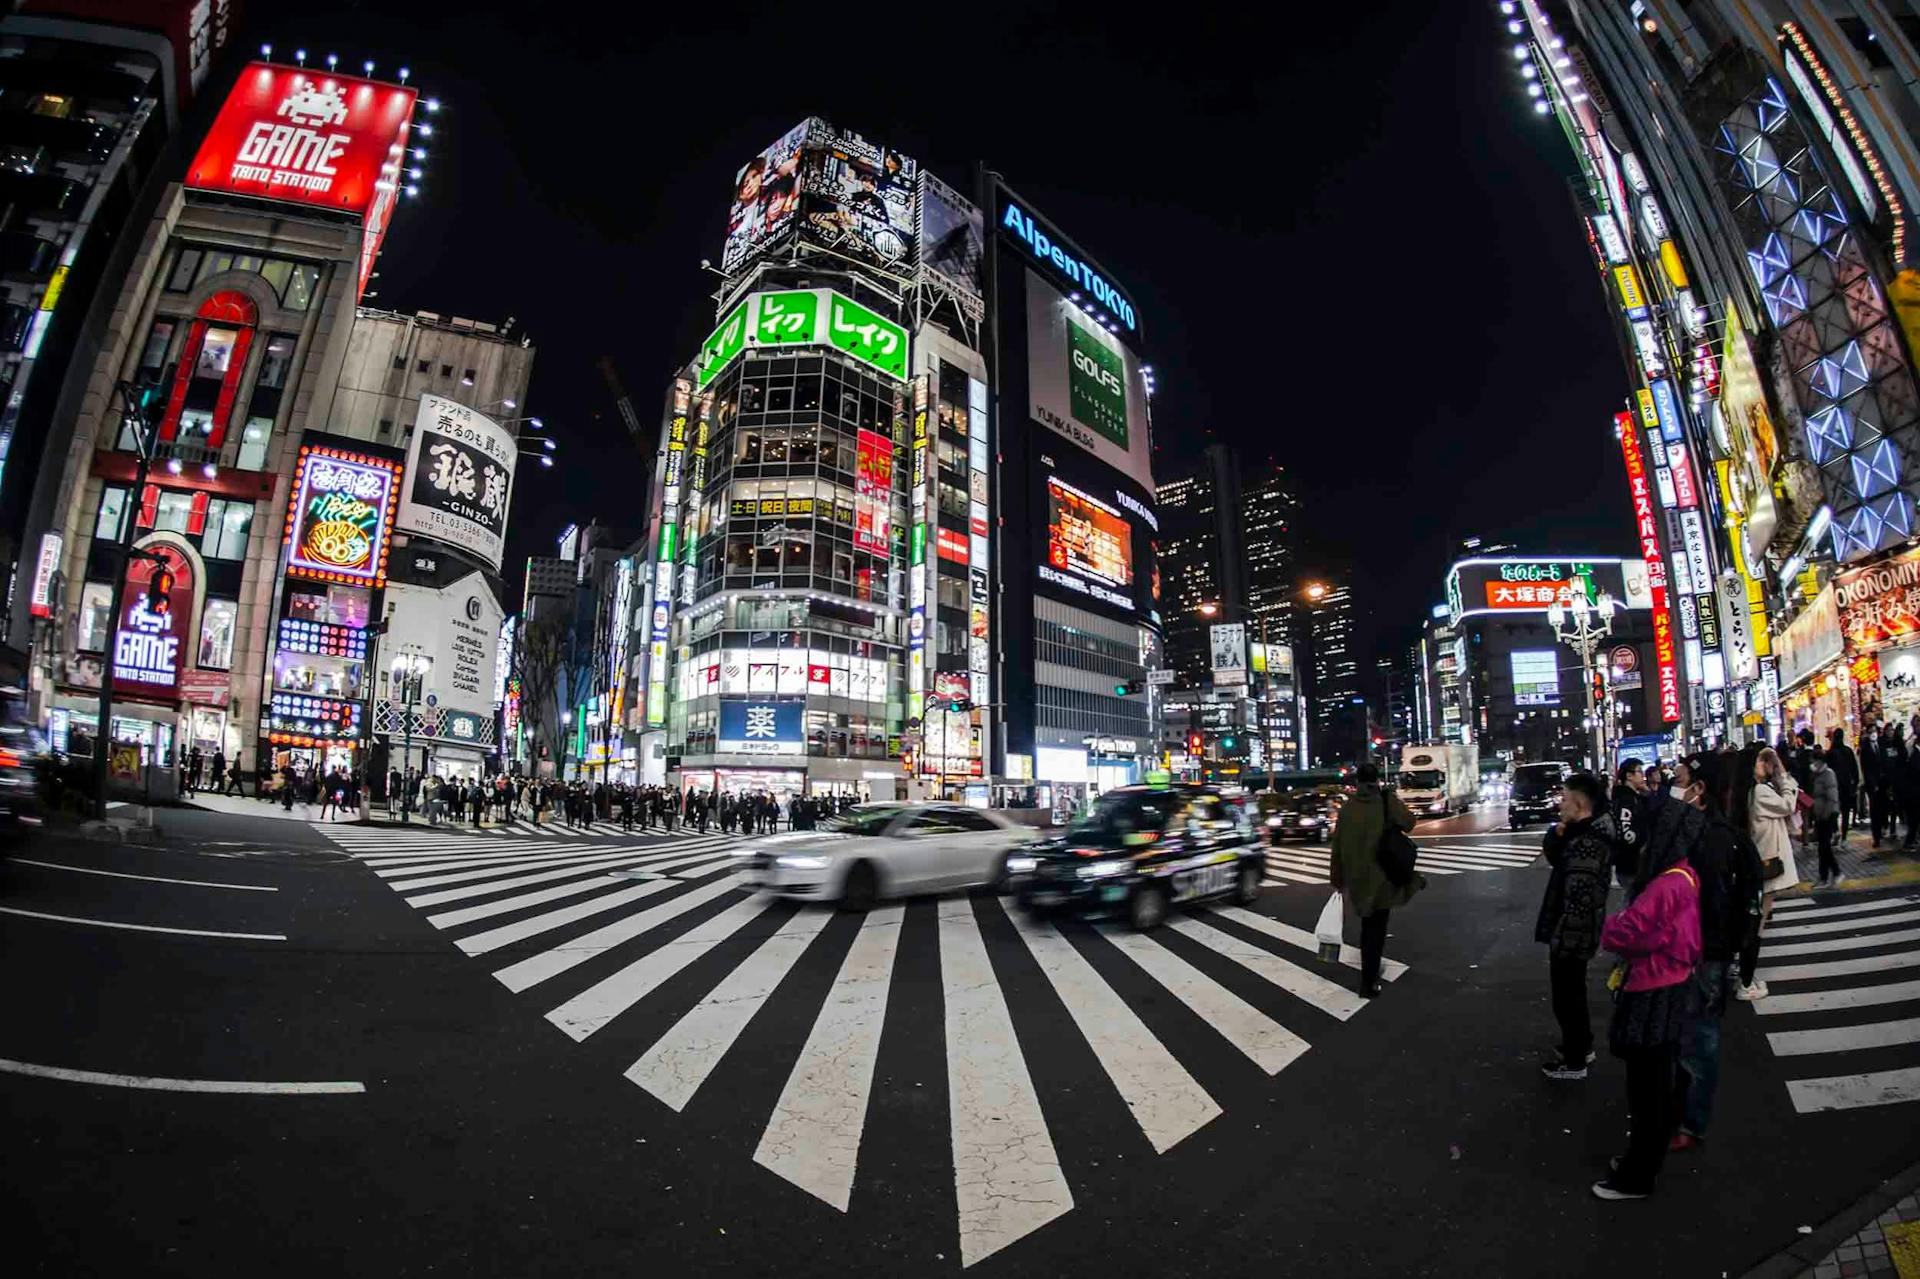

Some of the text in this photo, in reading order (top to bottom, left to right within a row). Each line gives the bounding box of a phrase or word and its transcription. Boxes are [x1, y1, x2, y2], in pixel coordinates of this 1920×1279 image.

[236, 121, 350, 175] GAME
[231, 163, 333, 192] TAITO STATION
[834, 304, 898, 354] レイク
[1073, 349, 1121, 397] GOLF5
[1632, 477, 1659, 560] エスパス
[1494, 586, 1578, 604] 大塚商会
[114, 631, 179, 673] GAME
[1655, 613, 1672, 662] パチンコ
[113, 666, 176, 686] TAITO STATION
[1661, 666, 1680, 717] エスパス
[745, 705, 777, 738] 薬
